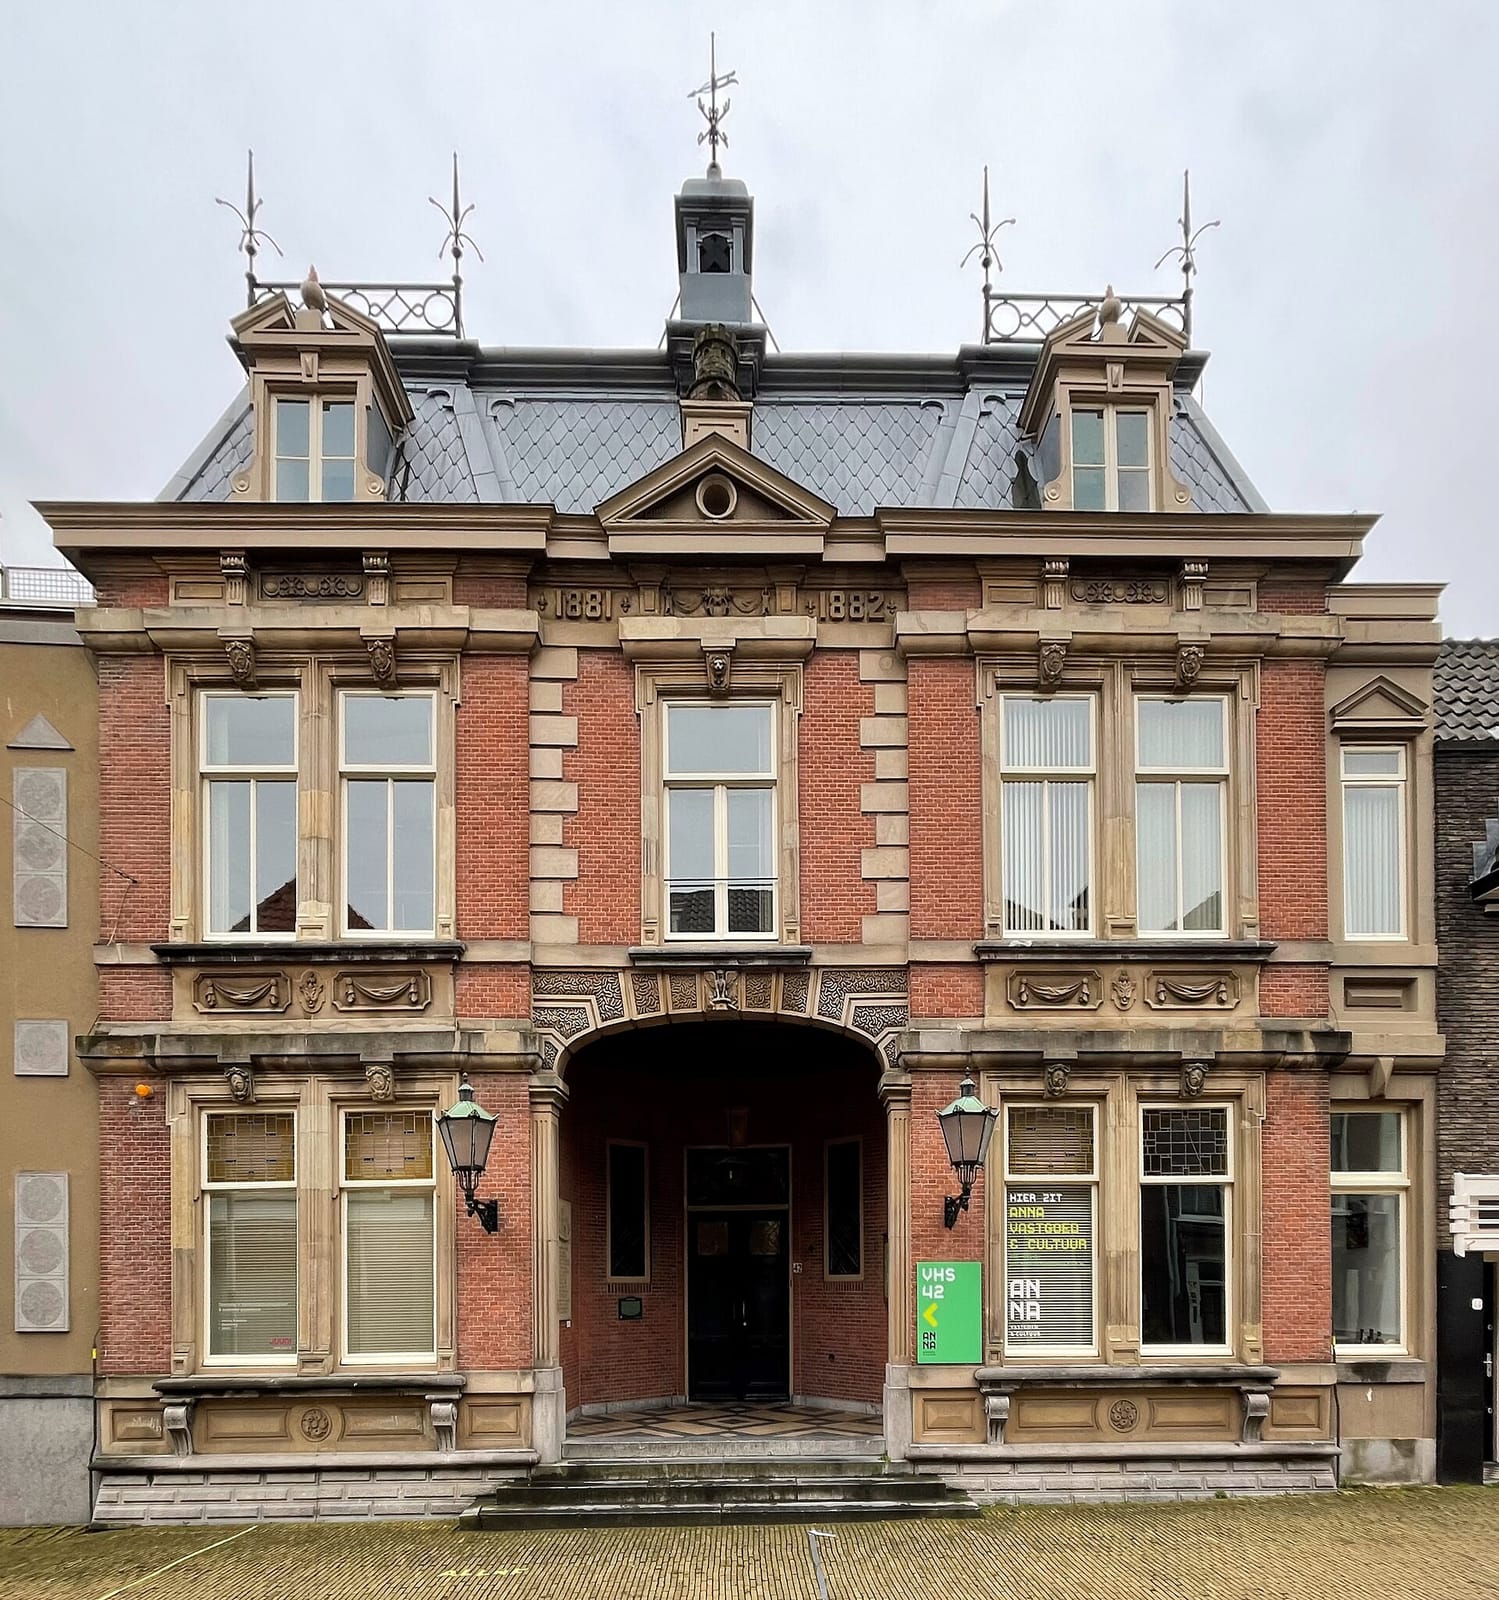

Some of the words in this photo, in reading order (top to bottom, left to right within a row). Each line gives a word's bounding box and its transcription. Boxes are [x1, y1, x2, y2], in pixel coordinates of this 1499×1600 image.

[556, 590, 612, 619] 1881
[819, 591, 885, 621] 1882
[1009, 1193, 1037, 1203] HIER
[1042, 1193, 1064, 1203] ZIT
[1009, 1206, 1045, 1218] ANNA
[1009, 1223, 1080, 1234] VASTGOED
[1027, 1238, 1087, 1250] CULTUUR
[922, 1267, 956, 1282] VHS
[922, 1284, 945, 1299] 42
[1010, 1279, 1041, 1299] AN
[1010, 1300, 1041, 1321] NA
[922, 1331, 936, 1341] AN
[922, 1340, 936, 1350] NA
